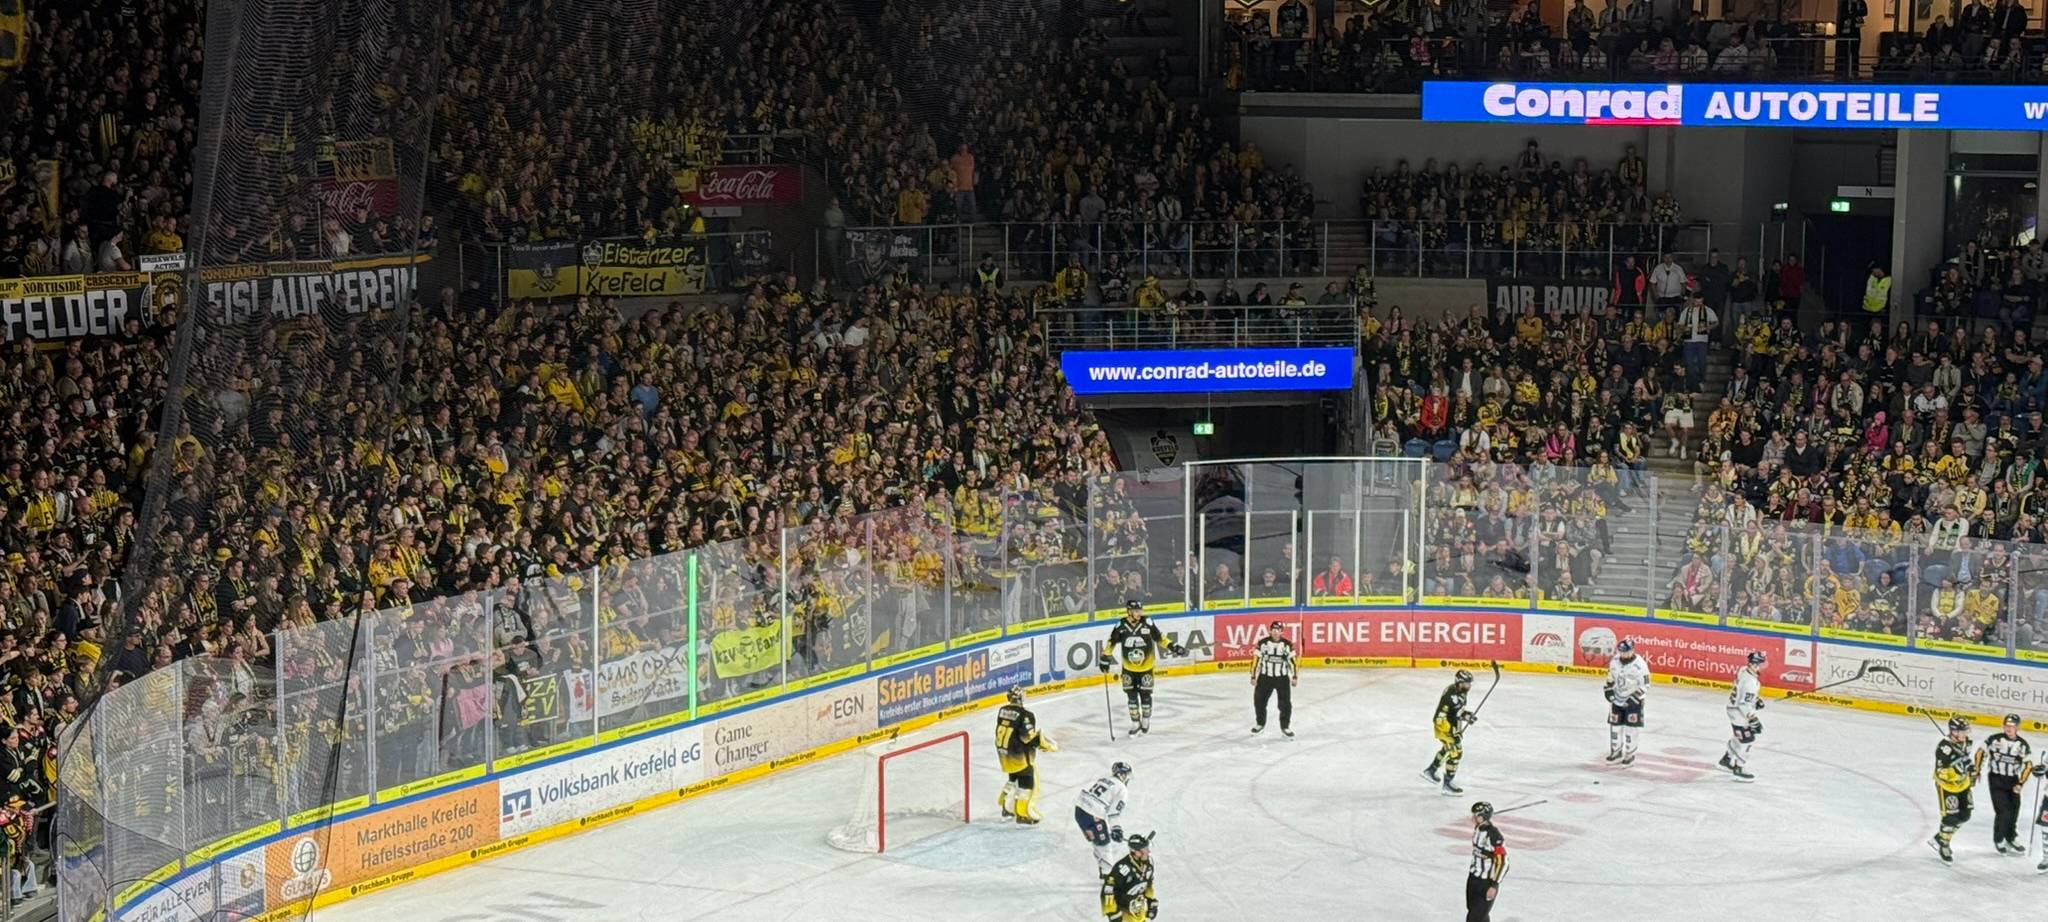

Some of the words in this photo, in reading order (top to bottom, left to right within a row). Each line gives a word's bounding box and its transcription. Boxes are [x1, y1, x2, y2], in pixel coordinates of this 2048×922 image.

[1484, 84, 1683, 119] Conrad
[1704, 91, 1939, 122] AUTOTEILE
[701, 170, 778, 200] Coca-Cola
[1865, 187, 1873, 197] N
[23, 280, 82, 294] NORTHSIDE
[86, 273, 139, 287] CRESCENTE
[1497, 285, 1536, 321] AIR
[3, 290, 129, 341] FELDER
[1089, 360, 1326, 380] www.conrad-autoteile.de
[1226, 622, 1301, 645] WAT
[1312, 622, 1370, 643] EINE
[1380, 621, 1507, 645] ENERGIE!
[1674, 637, 1689, 649] für
[1691, 640, 1717, 652] deine
[1365, 658, 1387, 666] Gruppe
[1448, 660, 1481, 668] Fischbach
[1564, 666, 1595, 675] Fischbach
[1869, 657, 1898, 669] HOTEL
[880, 671, 932, 705] Starke
[935, 653, 986, 690] Bande!
[1680, 677, 1710, 688] Fischbach
[1906, 675, 1935, 690] Hof
[1992, 672, 2024, 684] HOTEL
[1829, 696, 1853, 706] Gruppe
[1953, 680, 2027, 702] Krefelder
[834, 694, 864, 720] EGN
[715, 723, 753, 746] Game
[715, 739, 769, 767] Changer
[538, 766, 619, 804] Volksbank
[624, 748, 677, 781] Krefeld
[681, 742, 701, 764] eG
[357, 814, 428, 847] Markthalle
[431, 798, 478, 825] Krefeld
[361, 831, 446, 869] Hafelsstraße
[450, 822, 474, 844] 200
[508, 836, 529, 848] Gruppe
[358, 876, 391, 893] Fischbach
[392, 869, 414, 883] Gruppe
